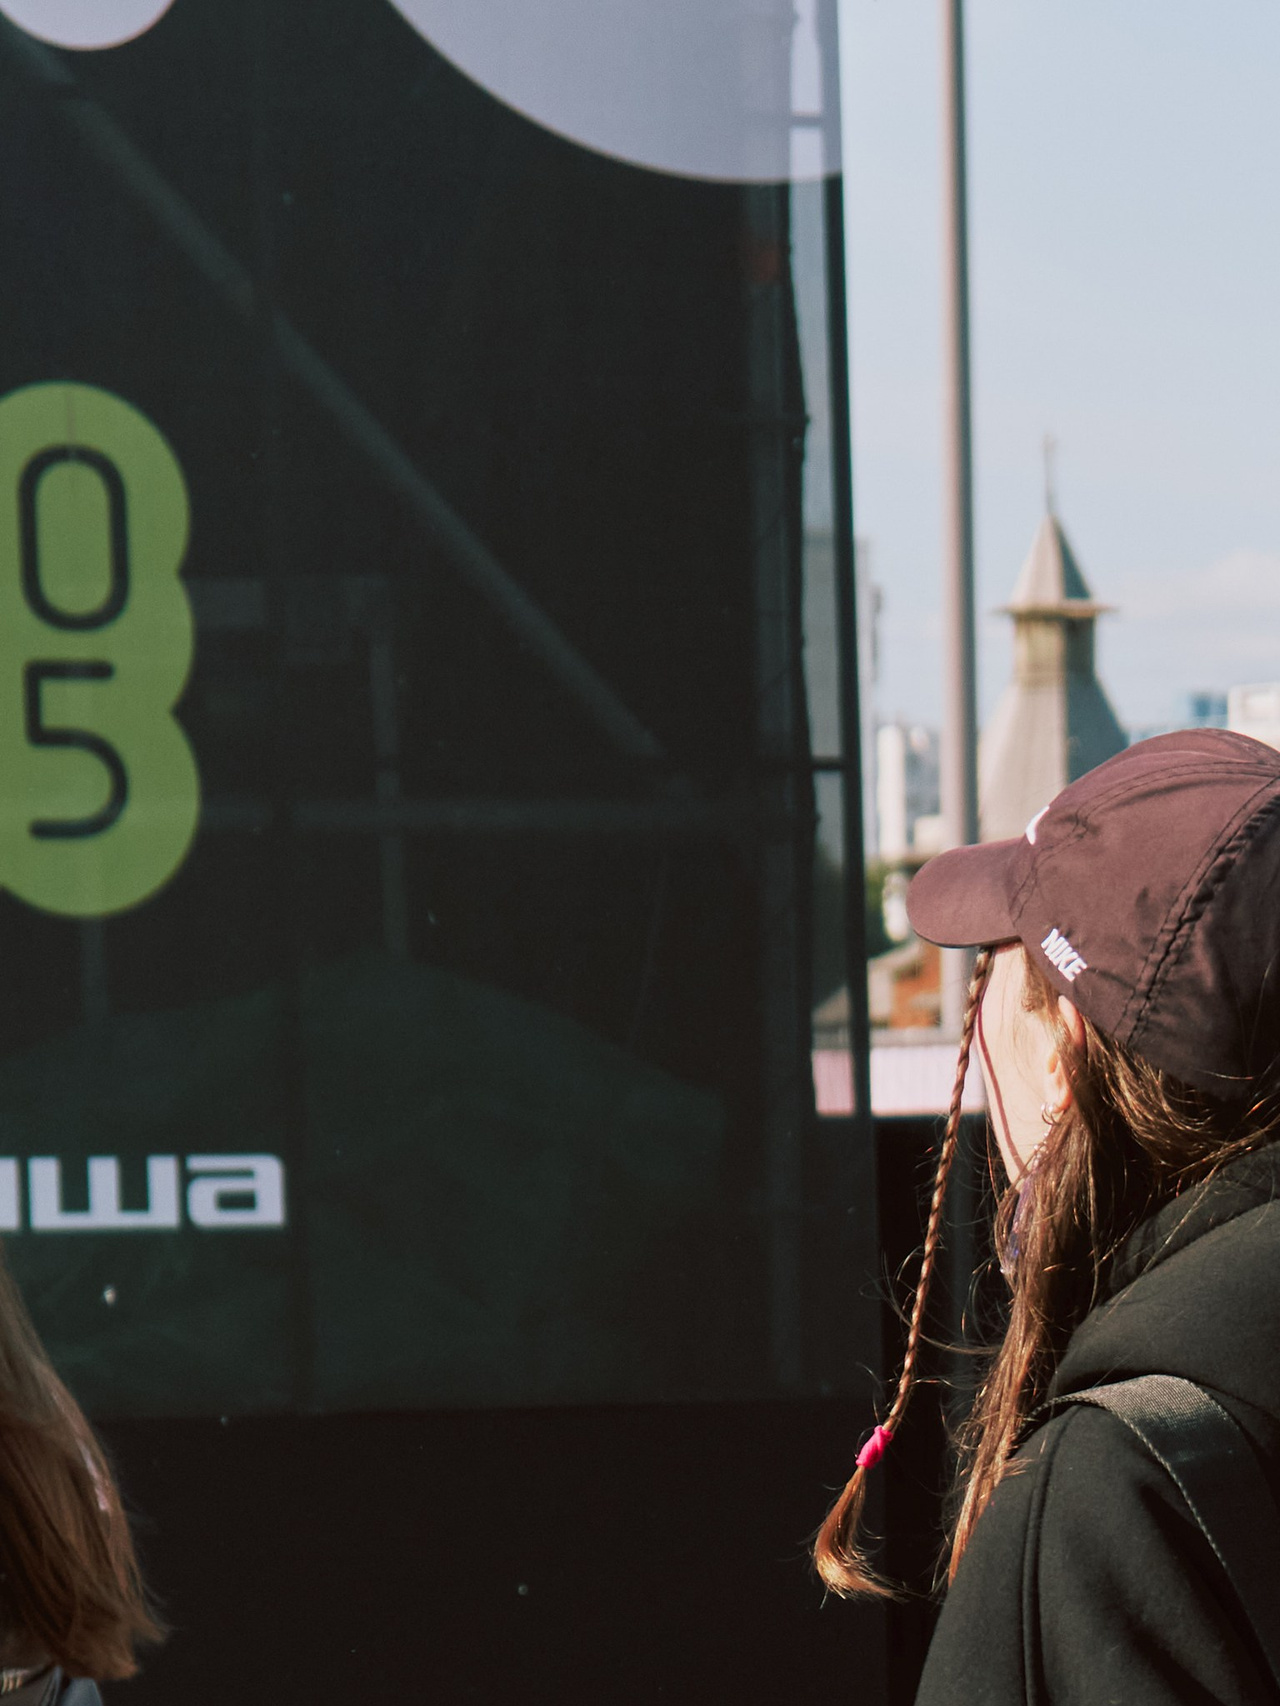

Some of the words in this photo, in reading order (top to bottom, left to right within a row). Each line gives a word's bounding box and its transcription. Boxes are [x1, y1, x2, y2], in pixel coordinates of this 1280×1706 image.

[17, 444, 131, 632] 0
[25, 659, 129, 839] 5
[1040, 927, 1088, 982] NIKE
[0, 1152, 287, 1231] ша
